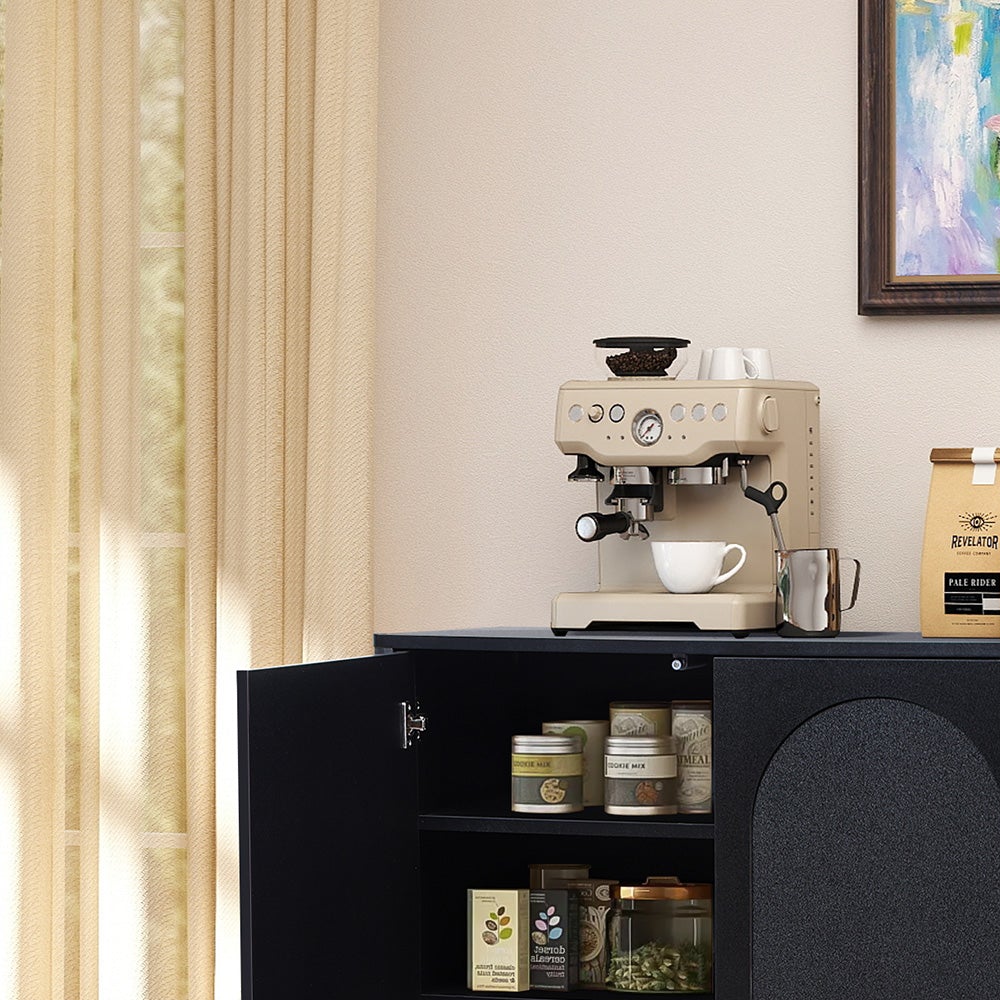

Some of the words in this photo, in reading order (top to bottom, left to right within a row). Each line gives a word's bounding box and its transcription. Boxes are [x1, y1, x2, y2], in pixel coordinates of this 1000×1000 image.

[951, 535, 999, 550] REVELATOR
[948, 578, 969, 587] PALE
[970, 578, 997, 587] RIDER
[677, 755, 710, 765] TMEAL
